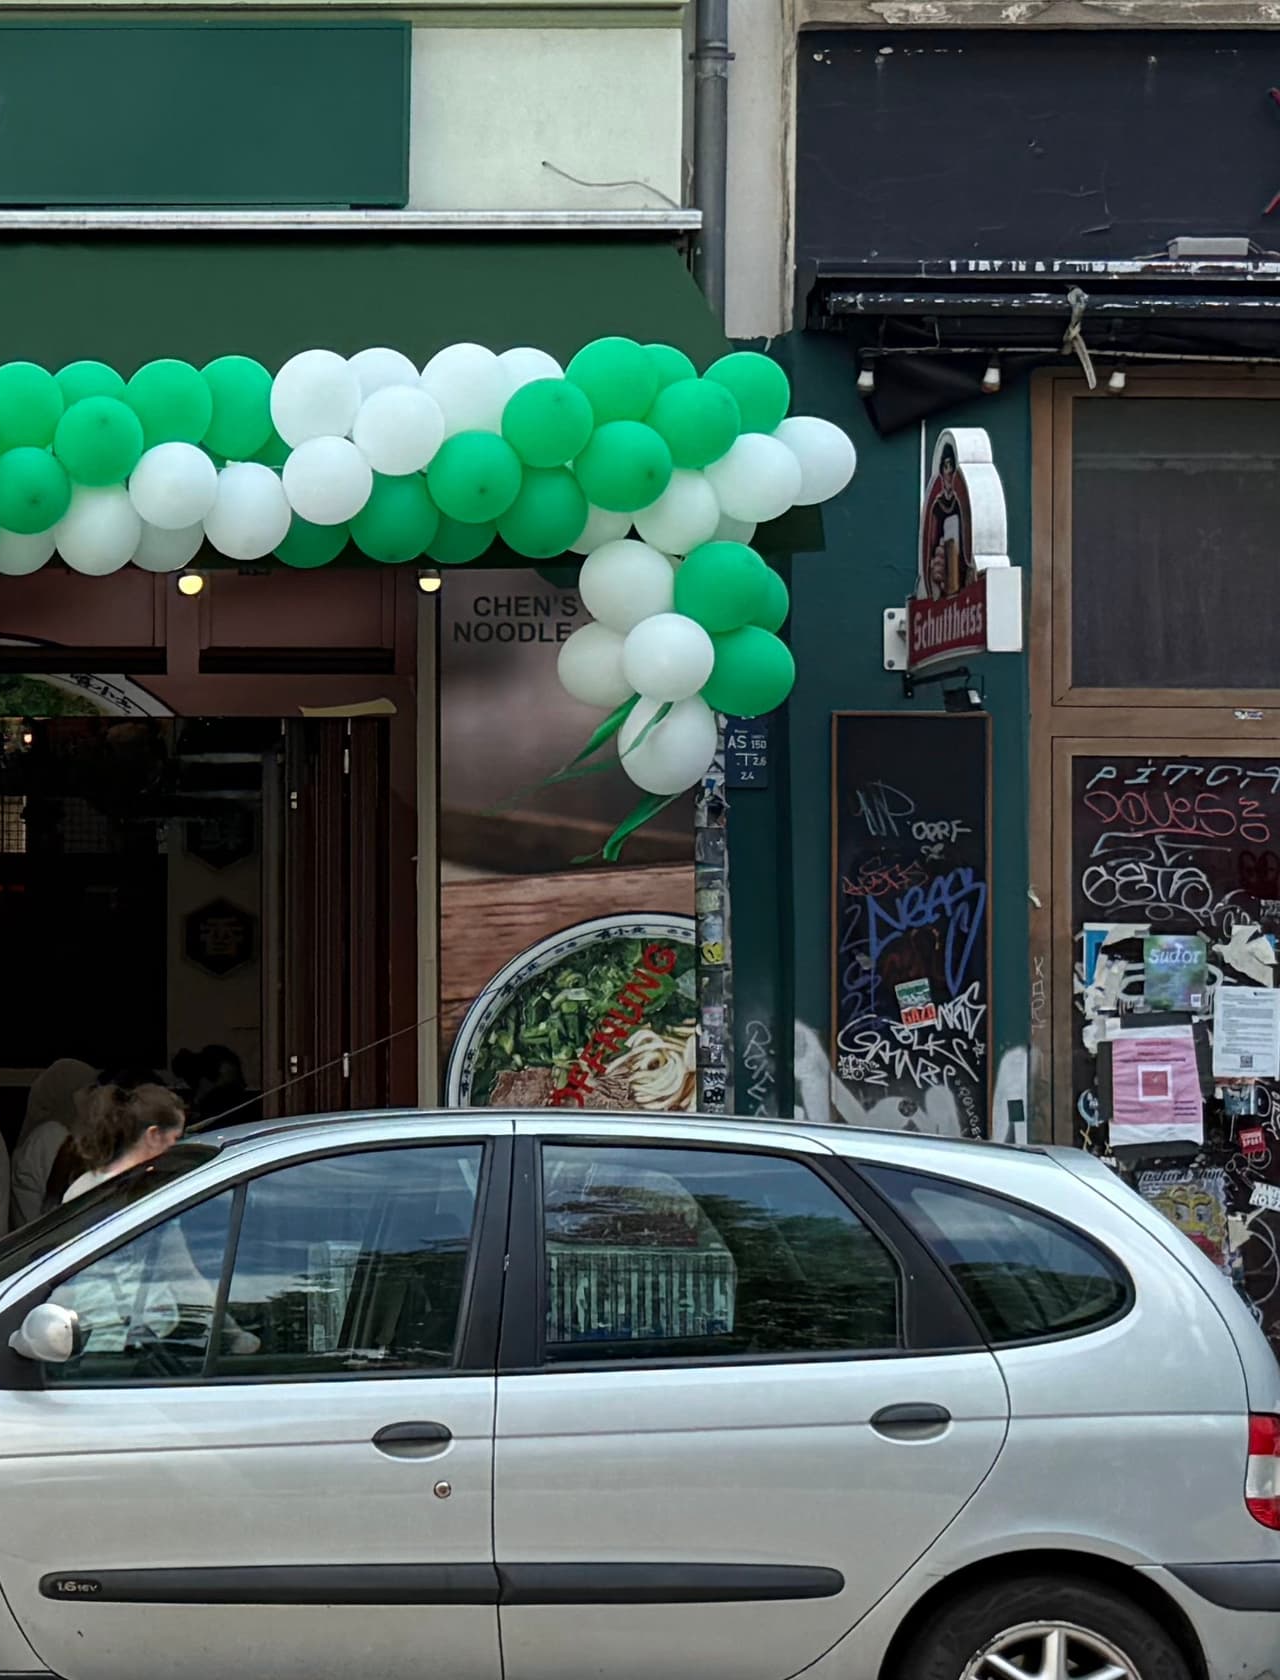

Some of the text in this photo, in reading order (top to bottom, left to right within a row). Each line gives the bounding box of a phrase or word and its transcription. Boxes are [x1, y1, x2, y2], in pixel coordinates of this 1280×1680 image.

[473, 595, 579, 617] CHEN'S
[452, 621, 572, 643] NOODLE
[913, 598, 984, 651] Schultheiss
